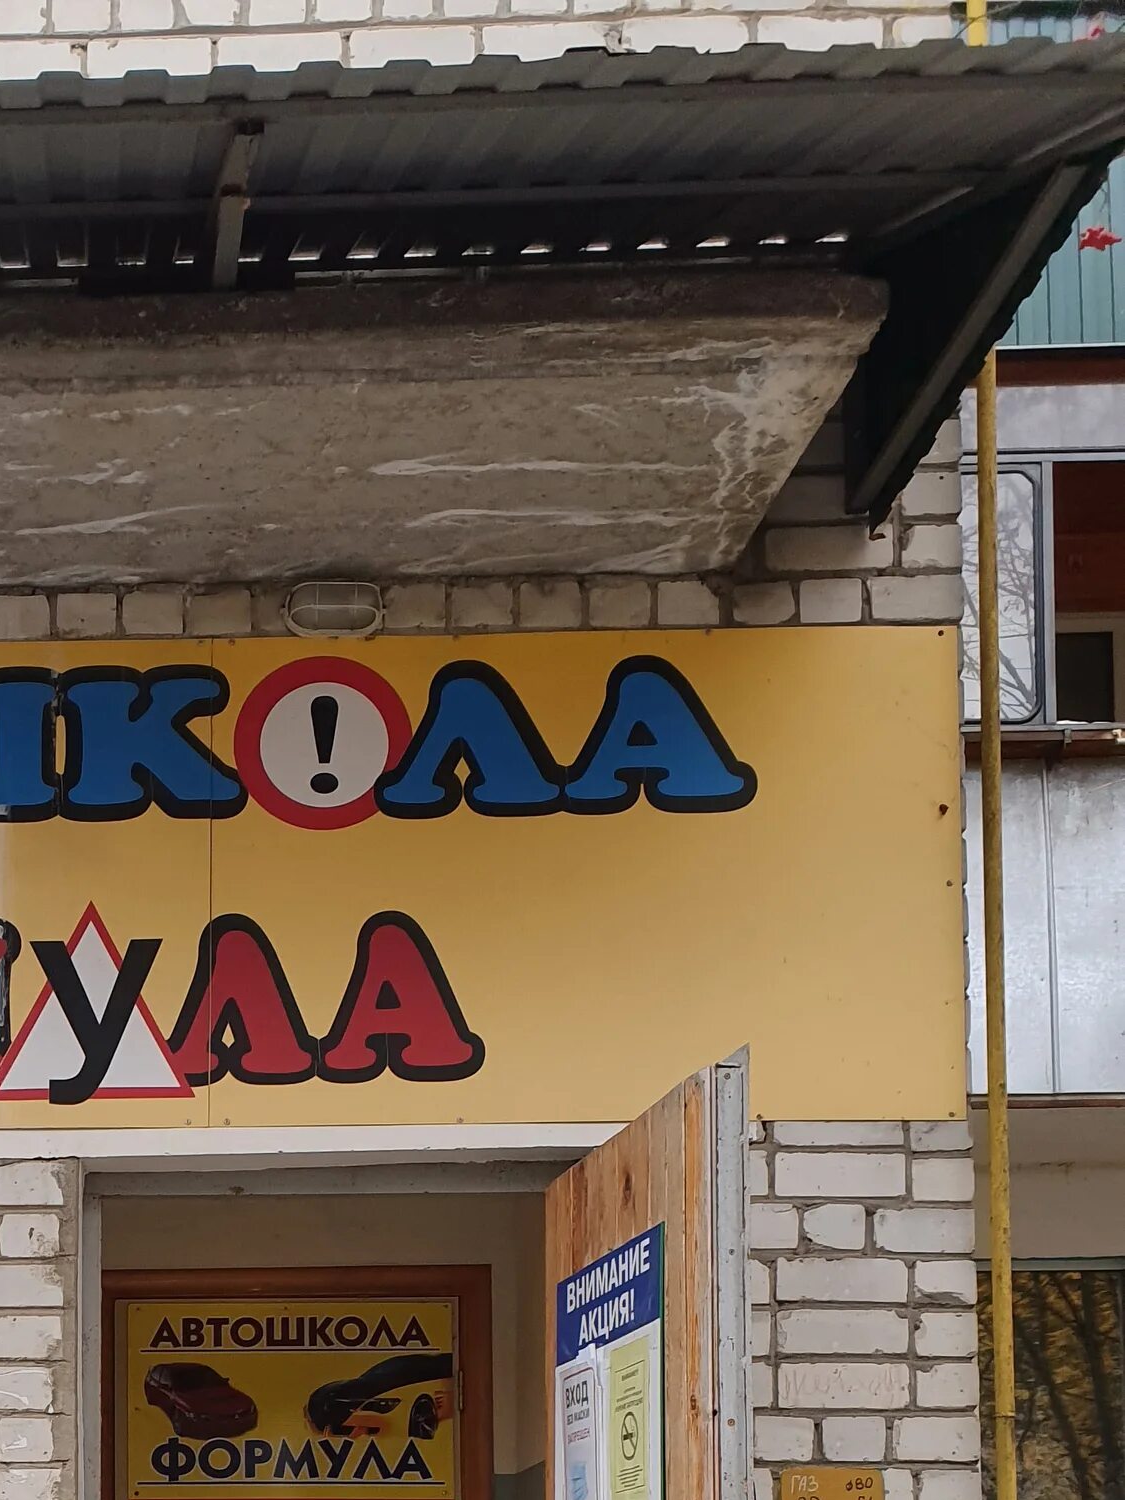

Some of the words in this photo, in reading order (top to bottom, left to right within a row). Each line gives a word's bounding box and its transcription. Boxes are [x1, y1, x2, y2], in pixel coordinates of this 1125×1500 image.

[566, 1237, 651, 1314] ВНИМАНИЕ
[149, 1316, 431, 1348] АВТОШКОЛА
[578, 1288, 635, 1346] АКЦИЯ!
[565, 1380, 589, 1408] ВХОД
[150, 1436, 433, 1482] ФОРМУЛА
[790, 1475, 819, 1495] ГАЗ
